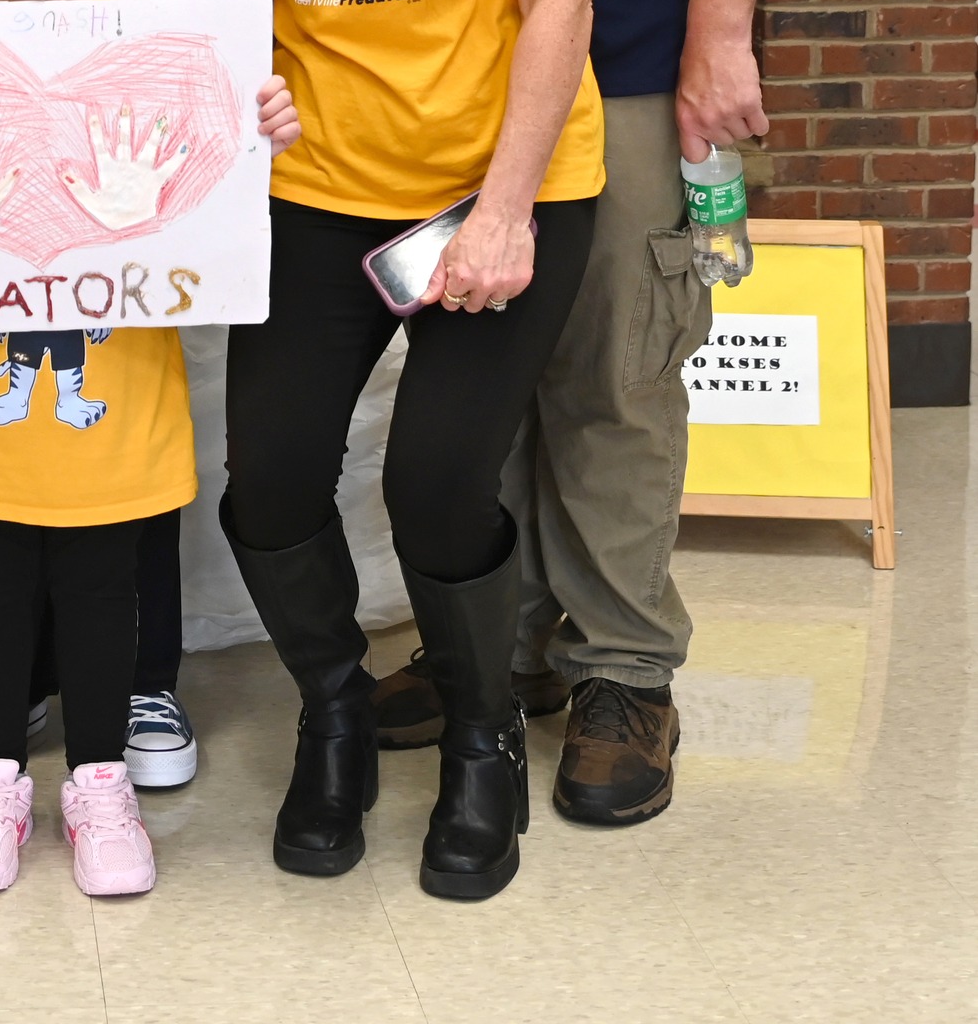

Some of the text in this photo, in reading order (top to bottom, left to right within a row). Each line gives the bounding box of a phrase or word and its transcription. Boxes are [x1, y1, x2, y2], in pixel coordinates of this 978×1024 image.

[716, 356, 781, 370] KSES
[684, 378, 800, 393] ANNEL 2!
